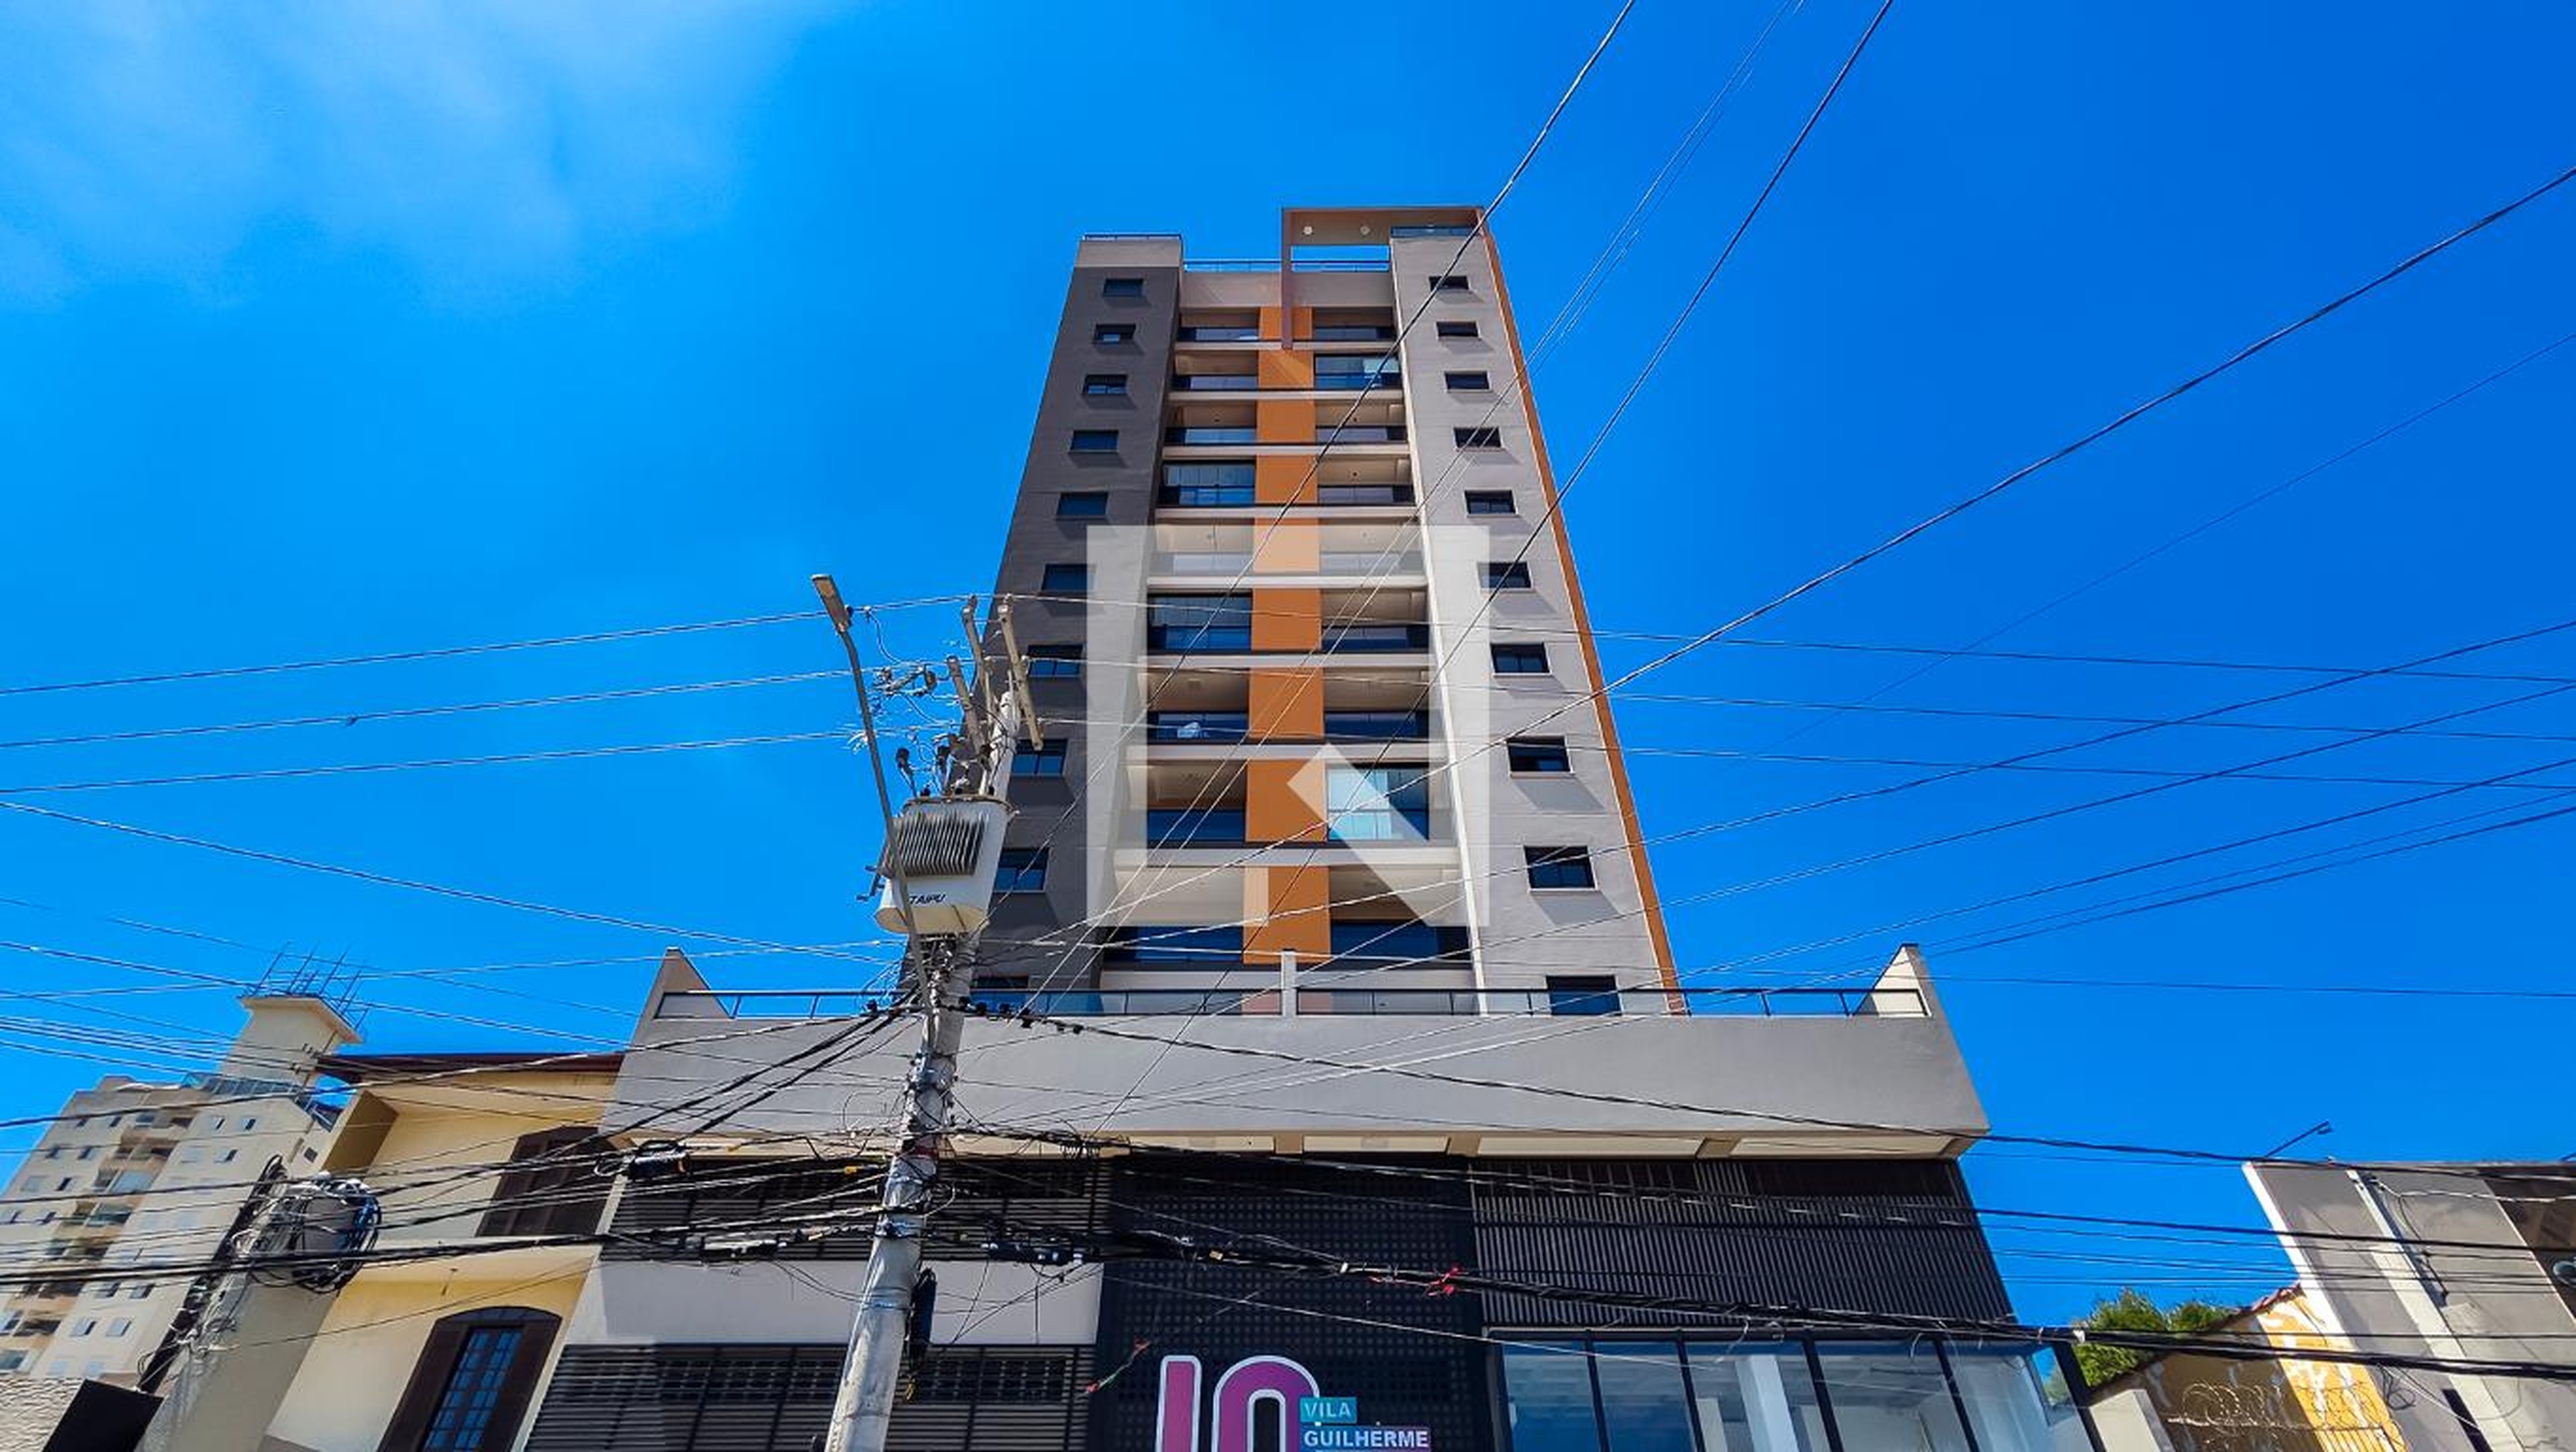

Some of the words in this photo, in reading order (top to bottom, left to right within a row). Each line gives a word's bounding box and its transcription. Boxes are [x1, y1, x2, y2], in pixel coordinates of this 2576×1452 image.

[908, 894, 946, 904] TAIPU
[1304, 1402, 1352, 1418] VILA
[1303, 1429, 1429, 1448] GUILHERME
